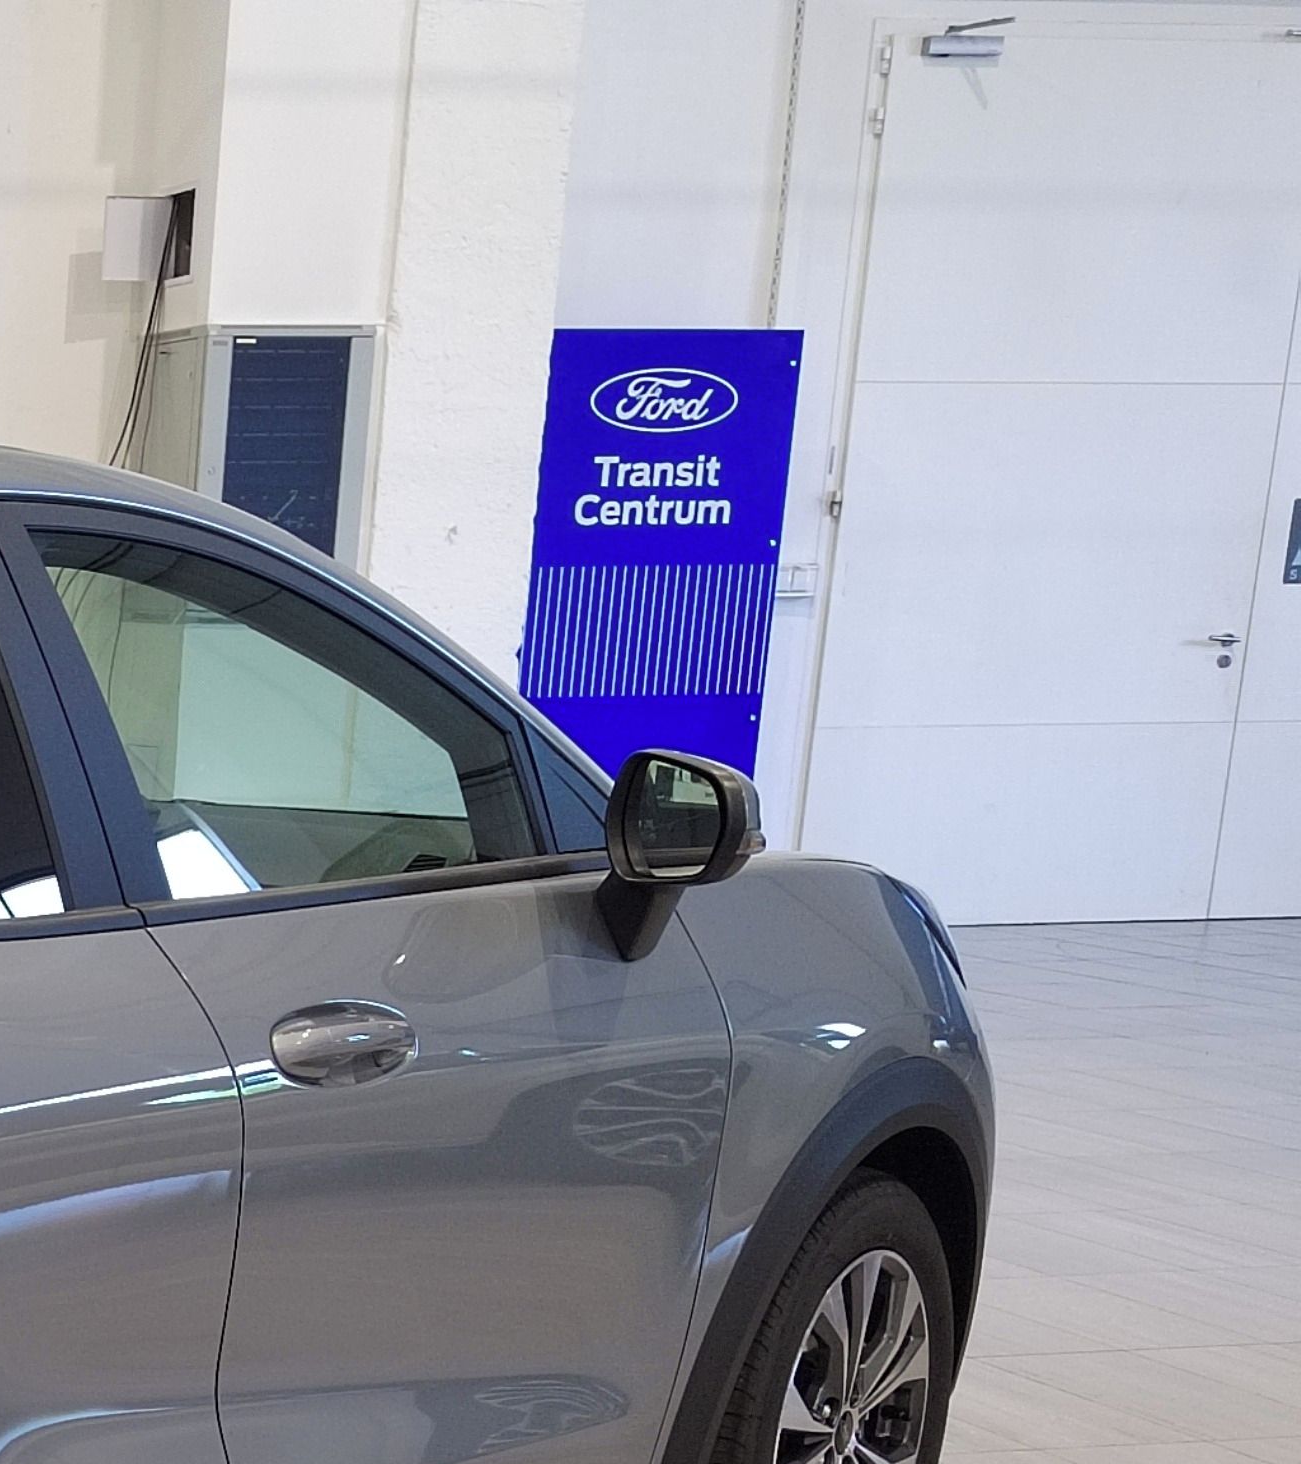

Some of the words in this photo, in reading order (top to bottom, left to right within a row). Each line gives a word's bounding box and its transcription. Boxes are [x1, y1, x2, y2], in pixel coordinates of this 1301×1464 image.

[615, 376, 714, 420] Ford
[594, 455, 721, 487] Transit
[574, 494, 731, 526] Centrum
